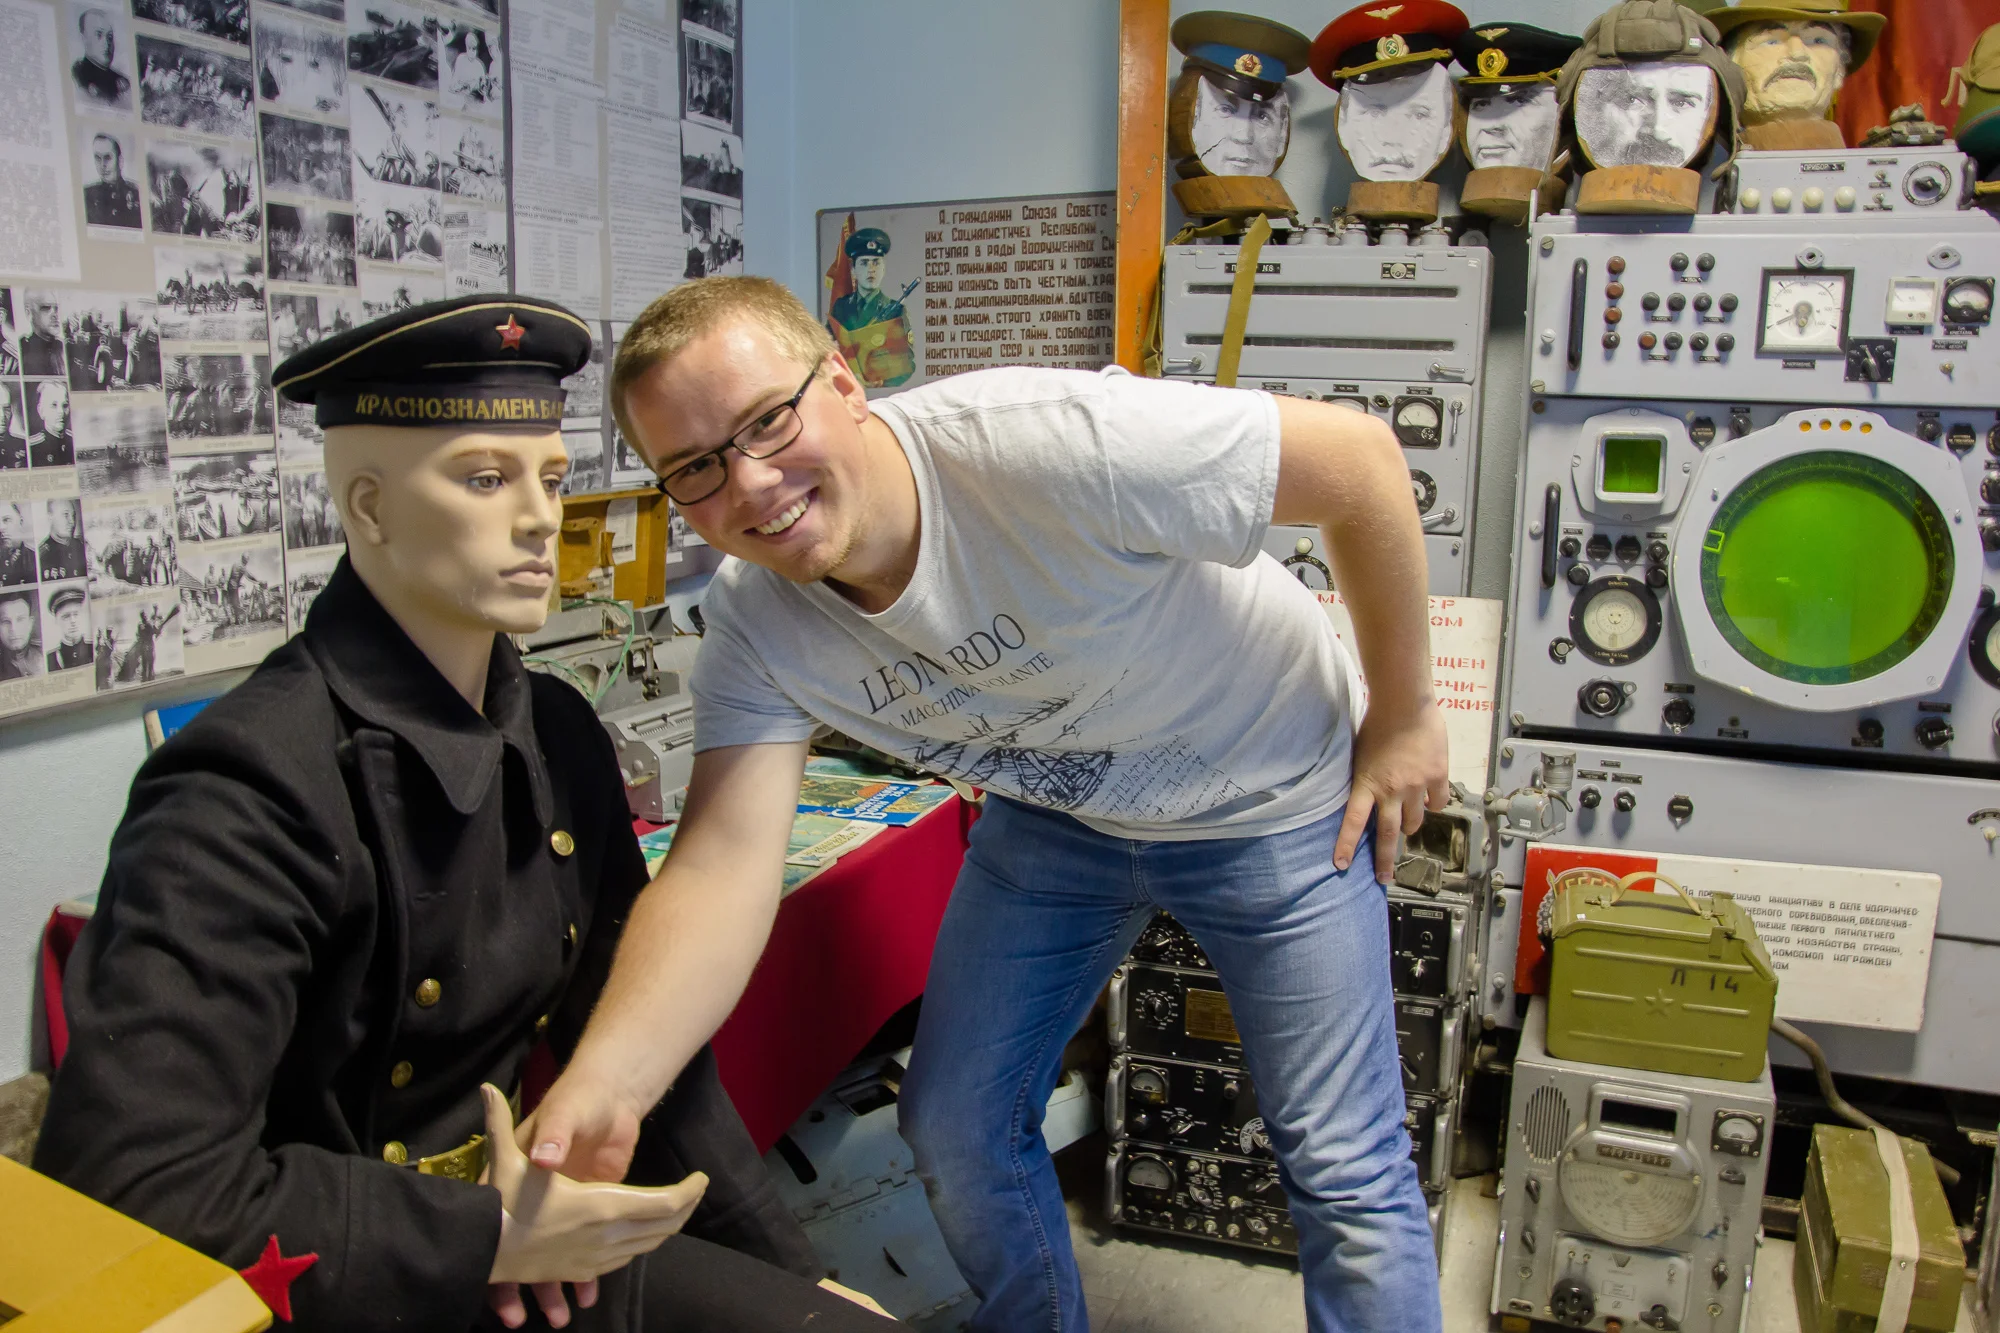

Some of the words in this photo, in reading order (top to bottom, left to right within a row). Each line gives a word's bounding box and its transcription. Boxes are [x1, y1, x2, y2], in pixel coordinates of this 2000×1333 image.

[925, 246, 969, 259] ВСТУПАЯ
[986, 244, 1016, 257] РЯДЫ
[956, 261, 1008, 275] ПРИНИМАЮ
[1014, 259, 1054, 272] ПРИСЯГУ
[925, 281, 953, 293] ВЕННО
[1004, 277, 1031, 291] БЫТЬ
[1039, 309, 1081, 323] ХРАНИТЬ
[925, 330, 945, 343] НУЮ
[1000, 343, 1022, 357] СССР
[901, 683, 982, 730] MACCHINA
[977, 651, 1054, 690] VOLANTE
[1753, 920, 1787, 931] ЛНЕНИЕ
